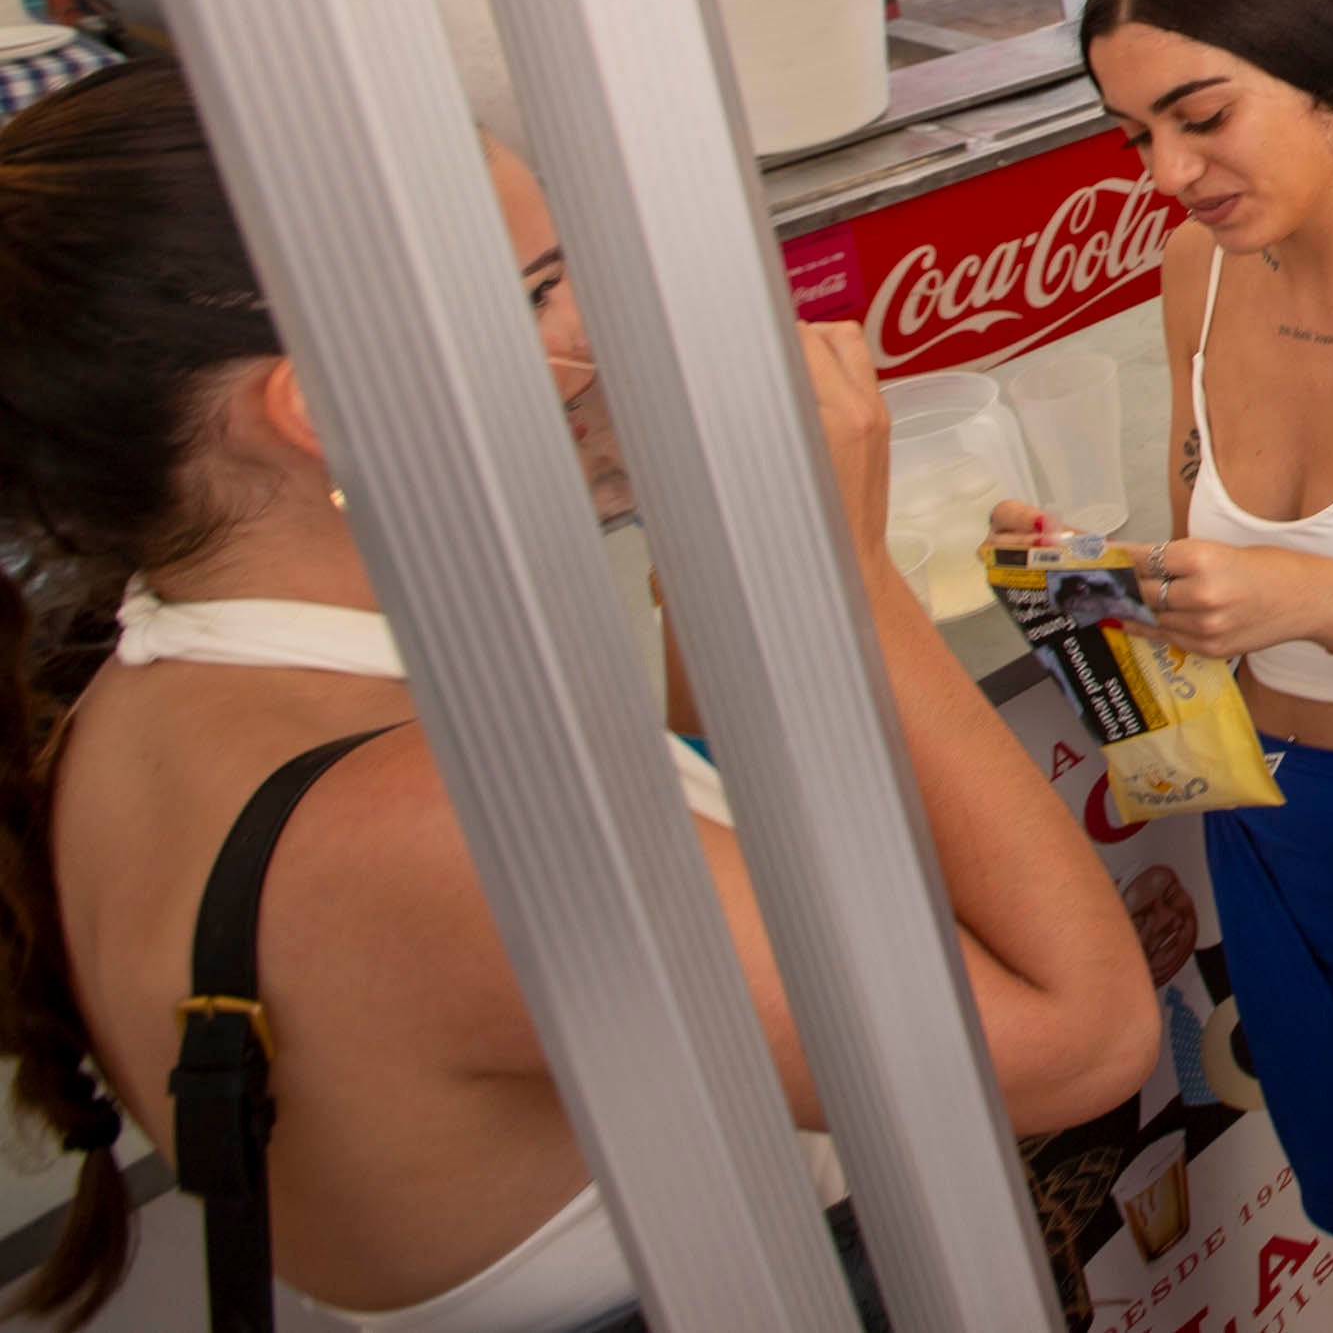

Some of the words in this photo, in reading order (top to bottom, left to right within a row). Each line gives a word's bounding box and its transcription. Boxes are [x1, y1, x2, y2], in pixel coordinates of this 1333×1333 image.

[863, 169, 1178, 370] Coca-Cola
[1062, 636, 1106, 704] provoca
[1089, 696, 1124, 743] Fumar
[1104, 676, 1141, 738] infartos
[1104, 1226, 1226, 1333] ESDE
[1238, 1167, 1293, 1227] 192
